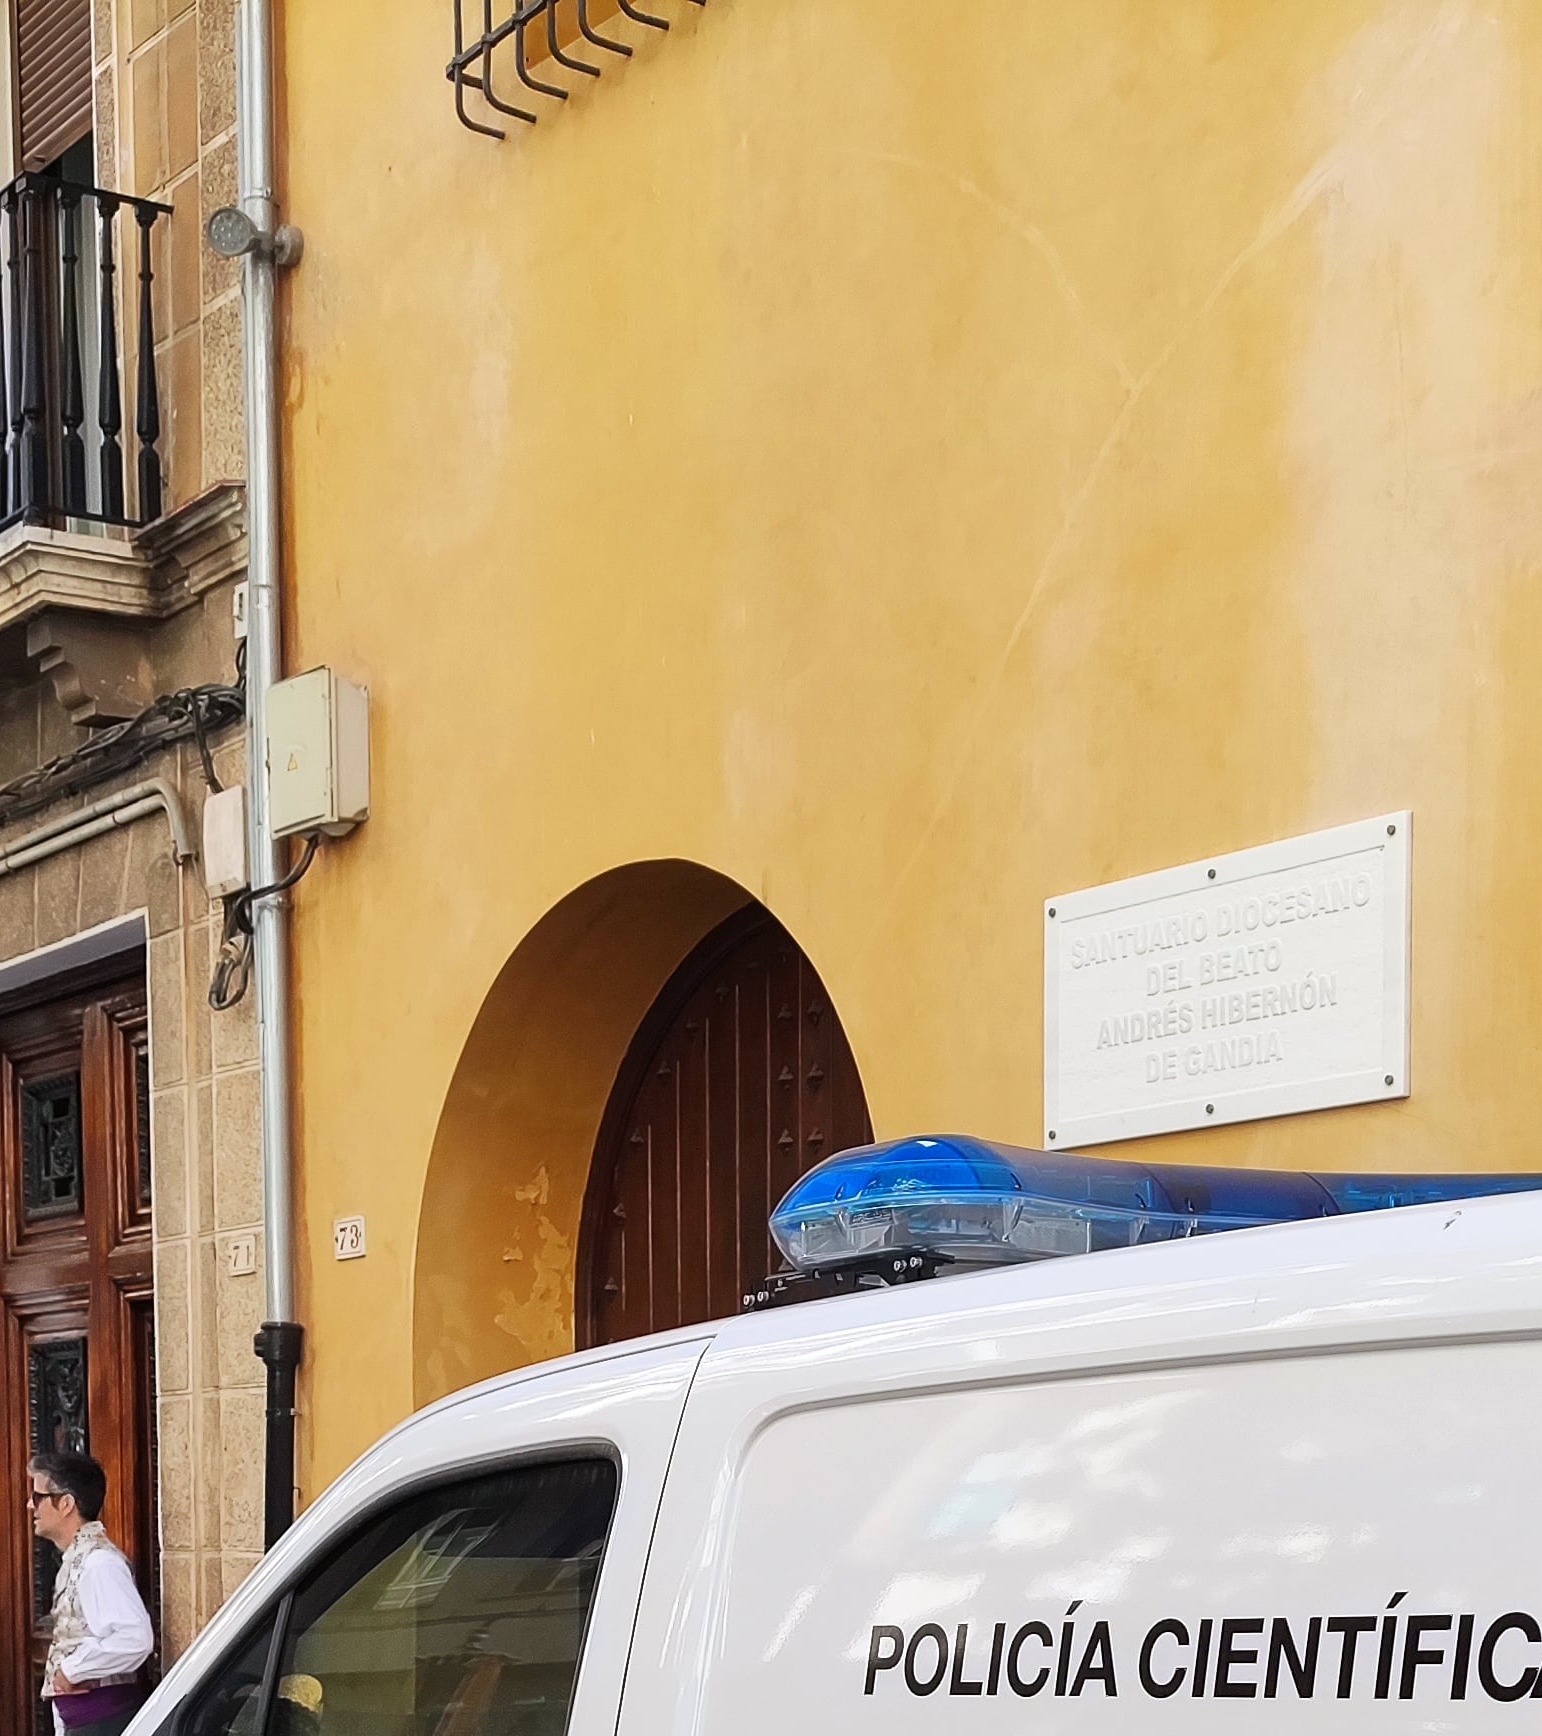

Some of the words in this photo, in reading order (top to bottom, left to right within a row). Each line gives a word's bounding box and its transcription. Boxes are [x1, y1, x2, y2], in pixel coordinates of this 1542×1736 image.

[1070, 909, 1208, 970] SANTUARIO
[1216, 871, 1373, 938] DIOCESANO
[1146, 959, 1193, 997] DEL
[1199, 937, 1284, 987] BEATO
[1095, 1000, 1194, 1050] ANDRÉS
[1201, 970, 1340, 1030] HIBERNÓN
[1145, 1049, 1178, 1084] DE
[232, 1244, 251, 1268] 71
[338, 1224, 360, 1251] 73
[861, 1599, 1119, 1698] POLICÍA
